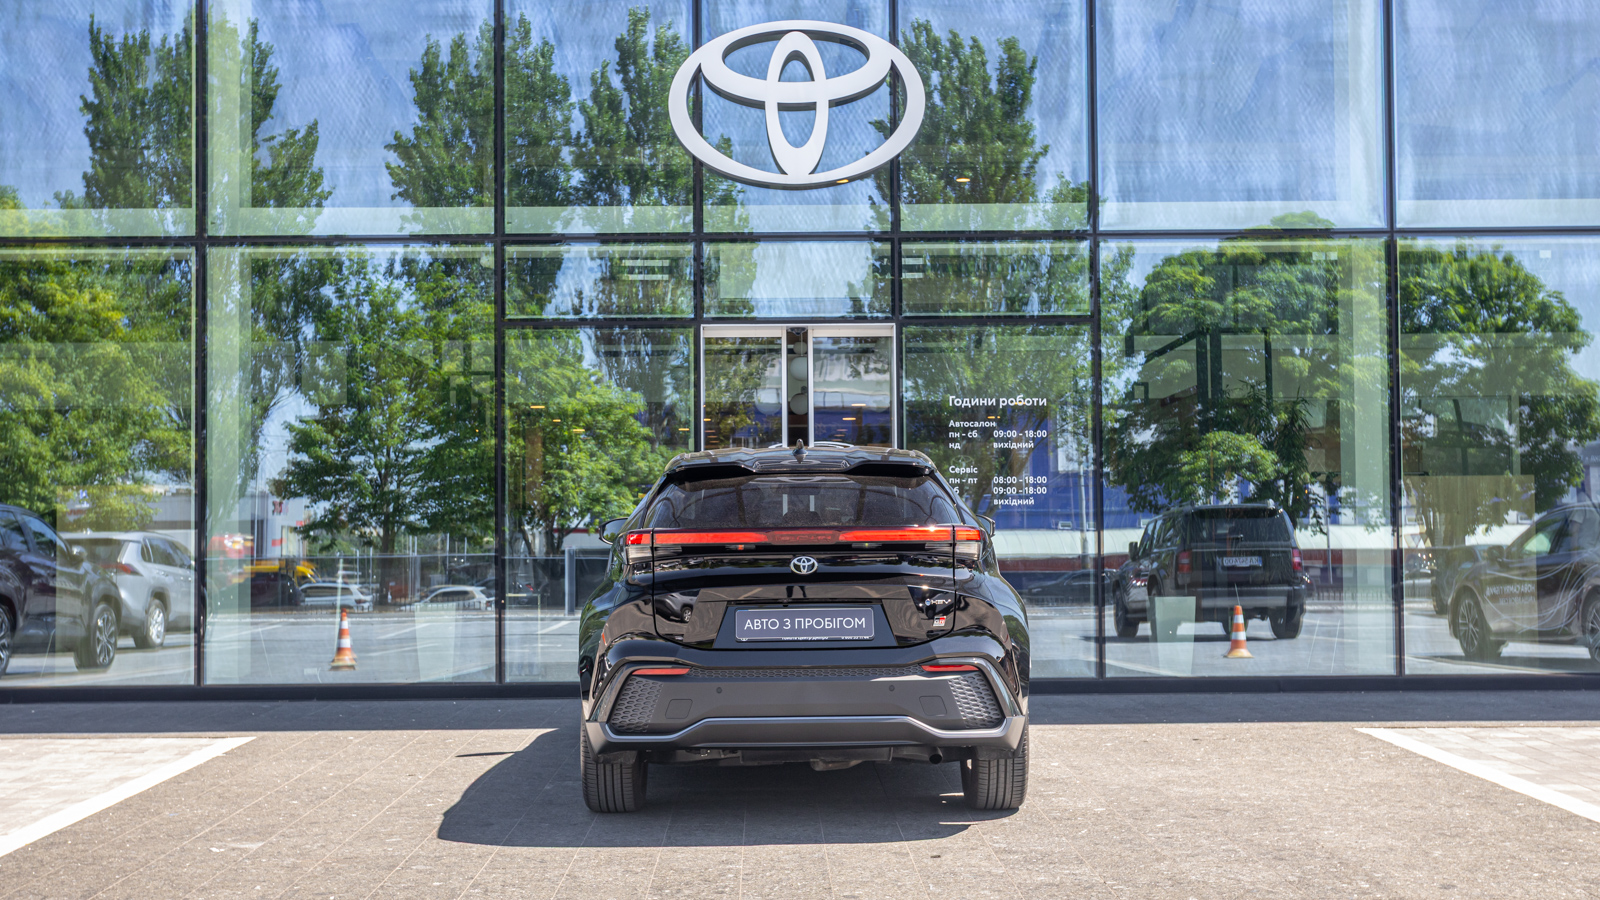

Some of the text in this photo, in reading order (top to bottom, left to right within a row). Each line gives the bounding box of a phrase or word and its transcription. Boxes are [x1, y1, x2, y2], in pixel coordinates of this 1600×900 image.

[949, 394, 1047, 408] Години роботи
[949, 420, 996, 428] Автосалон
[967, 430, 978, 438] сб
[993, 430, 1017, 438] 09:00
[1024, 430, 1047, 438] 18:00
[993, 441, 1034, 449] вихідний
[949, 466, 978, 475] Сервіс
[993, 476, 1017, 484] 08:00
[1024, 476, 1047, 484] 18:00
[993, 486, 1017, 494] 09:00
[1024, 486, 1047, 494] 18:00
[993, 497, 1034, 506] вихідний
[744, 618, 780, 630] АВТО
[795, 617, 866, 629] ПРОБІГОМ
